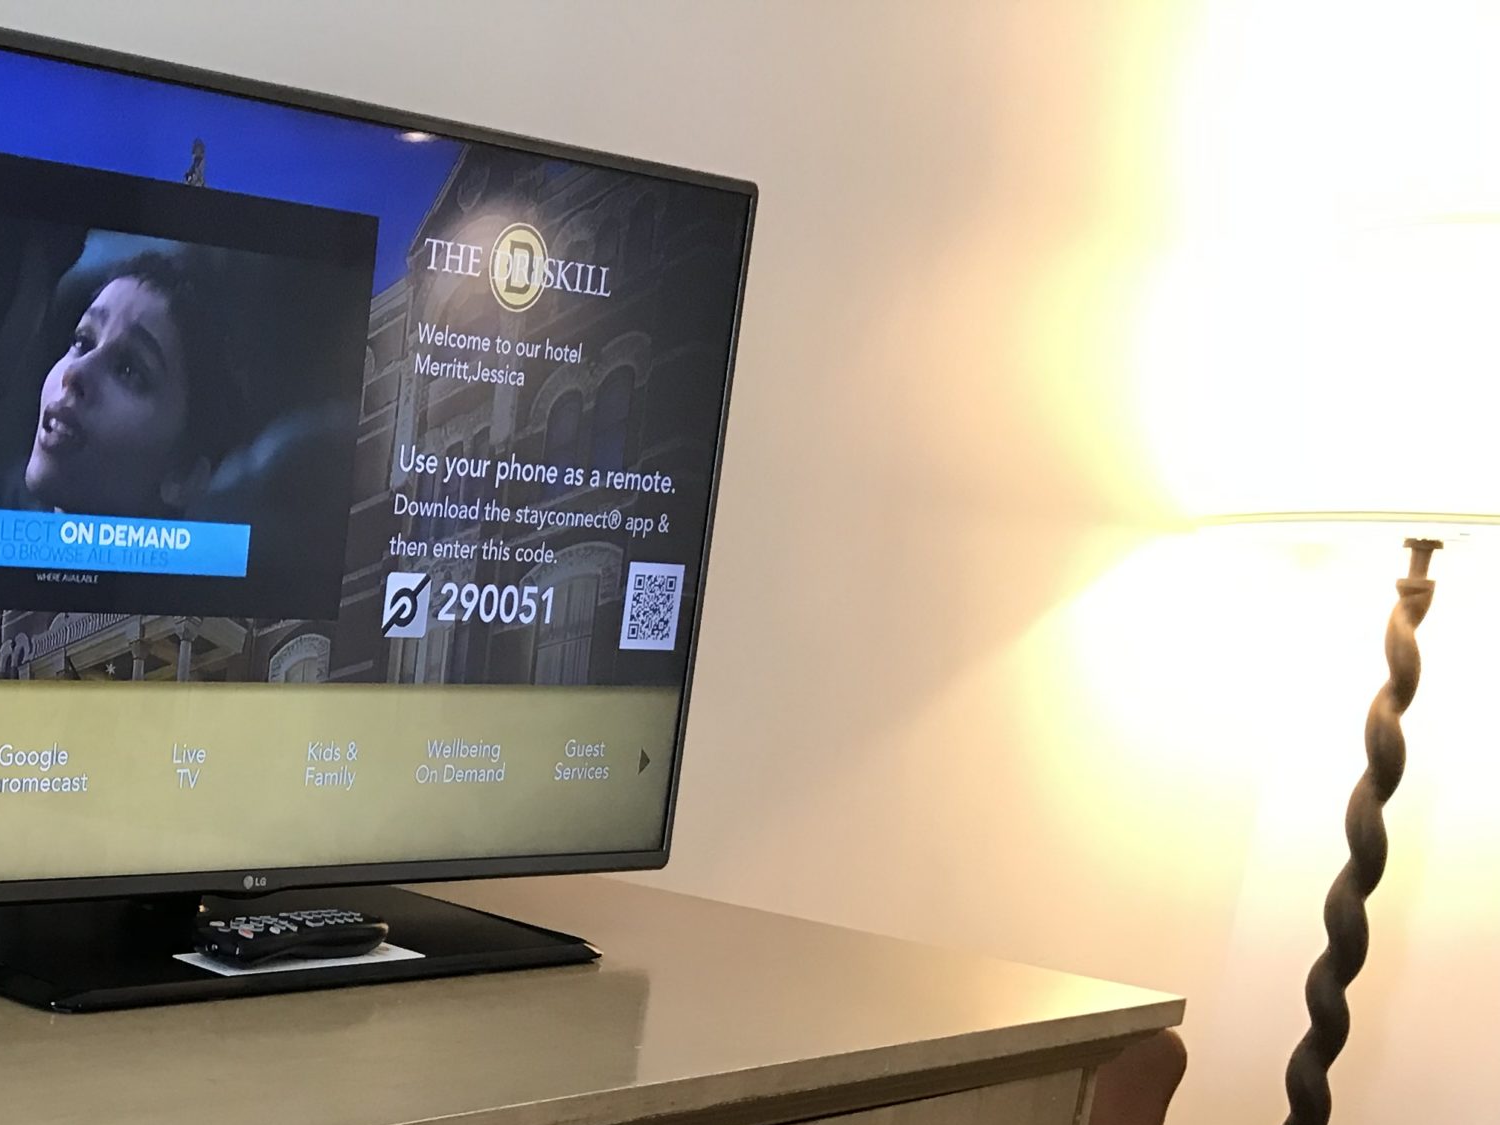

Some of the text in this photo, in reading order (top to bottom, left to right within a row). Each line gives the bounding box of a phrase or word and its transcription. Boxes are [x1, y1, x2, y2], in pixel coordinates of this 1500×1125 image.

[424, 238, 612, 298] THE DRISKILL
[418, 322, 582, 364] Welcome to our hotel
[414, 353, 525, 386] Merritt,Jessica
[399, 444, 676, 494] Use your phone as a remote.
[393, 494, 480, 521] Download
[484, 500, 510, 522] the
[625, 514, 654, 538] app
[657, 513, 670, 533] &
[60, 521, 94, 545] ON
[99, 523, 191, 550] DEMAND
[18, 543, 84, 564] BROWSE
[87, 547, 116, 566] ALL
[120, 549, 168, 567] TITLES
[389, 533, 558, 564] then enter this code.
[437, 582, 555, 625] 290051
[172, 743, 207, 764] Live
[307, 741, 358, 762] Kids &
[426, 738, 501, 761] Wellbeing
[565, 739, 605, 759] Guest
[177, 769, 200, 788] TV
[305, 766, 356, 790] Family
[415, 763, 506, 783] On Demand
[554, 763, 609, 781] Services
[254, 877, 267, 887] LG
